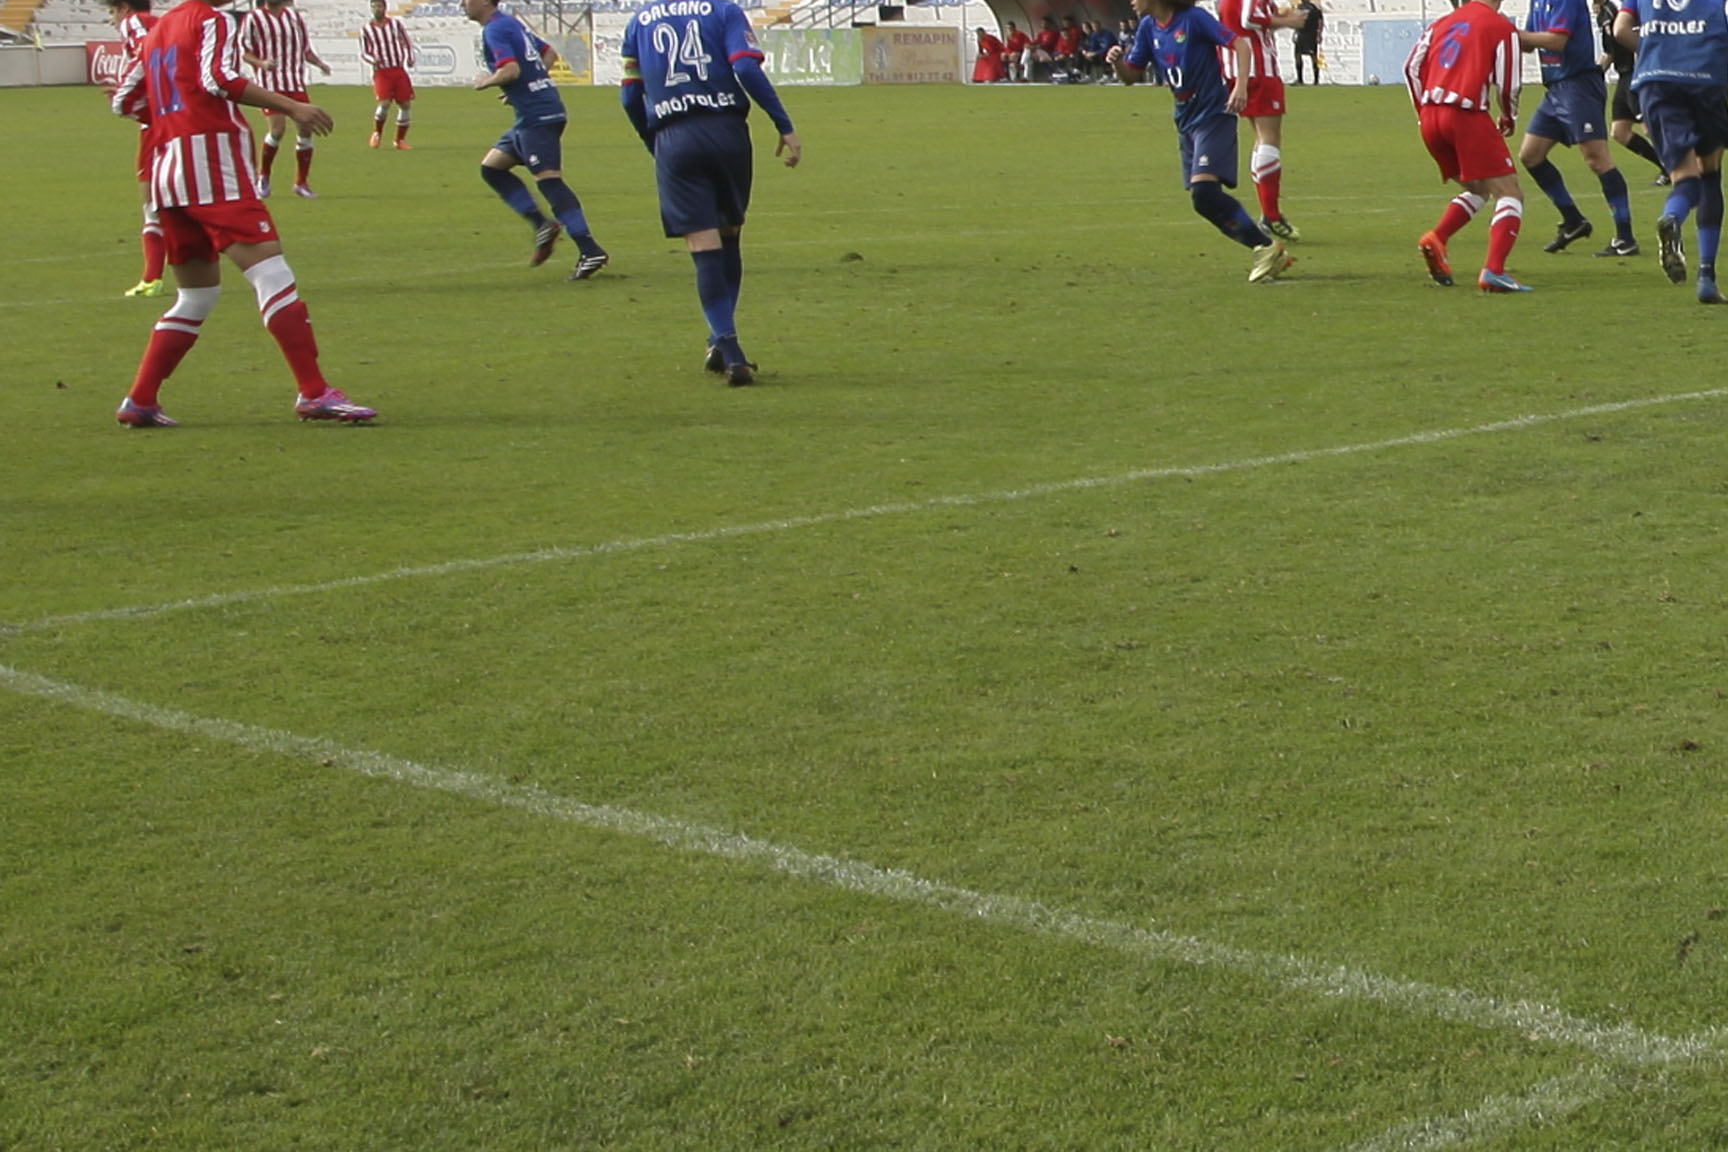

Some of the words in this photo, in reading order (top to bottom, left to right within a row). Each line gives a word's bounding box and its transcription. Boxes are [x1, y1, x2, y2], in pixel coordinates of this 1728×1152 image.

[638, 0, 712, 26] GALEANO
[653, 19, 712, 87] 24
[1440, 21, 1471, 69] 6
[150, 45, 185, 117] 11
